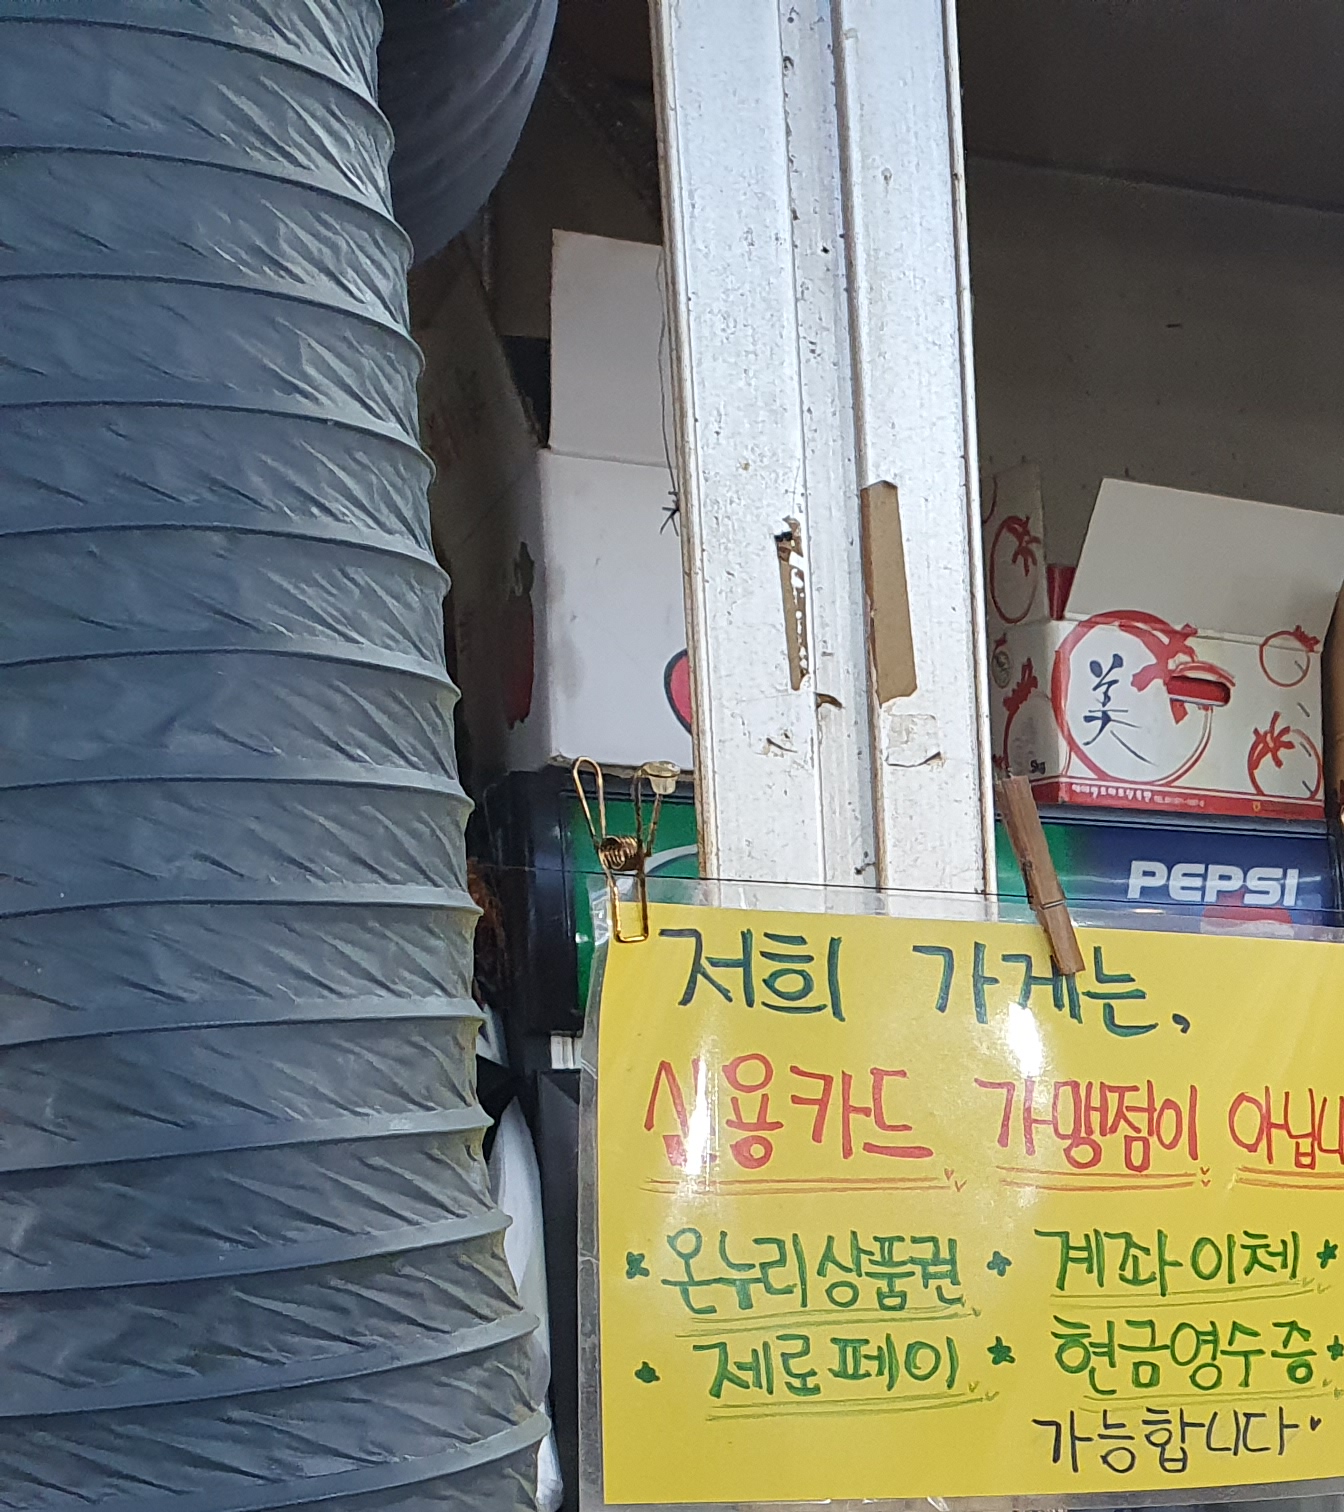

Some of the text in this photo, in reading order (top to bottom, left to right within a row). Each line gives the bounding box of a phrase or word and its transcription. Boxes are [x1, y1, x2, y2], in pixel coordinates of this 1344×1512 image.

[1127, 860, 1300, 907] PEPSI
[659, 929, 844, 1022] 저희
[644, 1053, 933, 1169] 신용카드
[976, 1080, 1198, 1172] 가맹점이
[660, 1228, 1300, 1315] 온누리상품권 계좌이체
[693, 1318, 1315, 1398] 제로페이 현금영수증
[1033, 1408, 1300, 1474] 가능합니다
